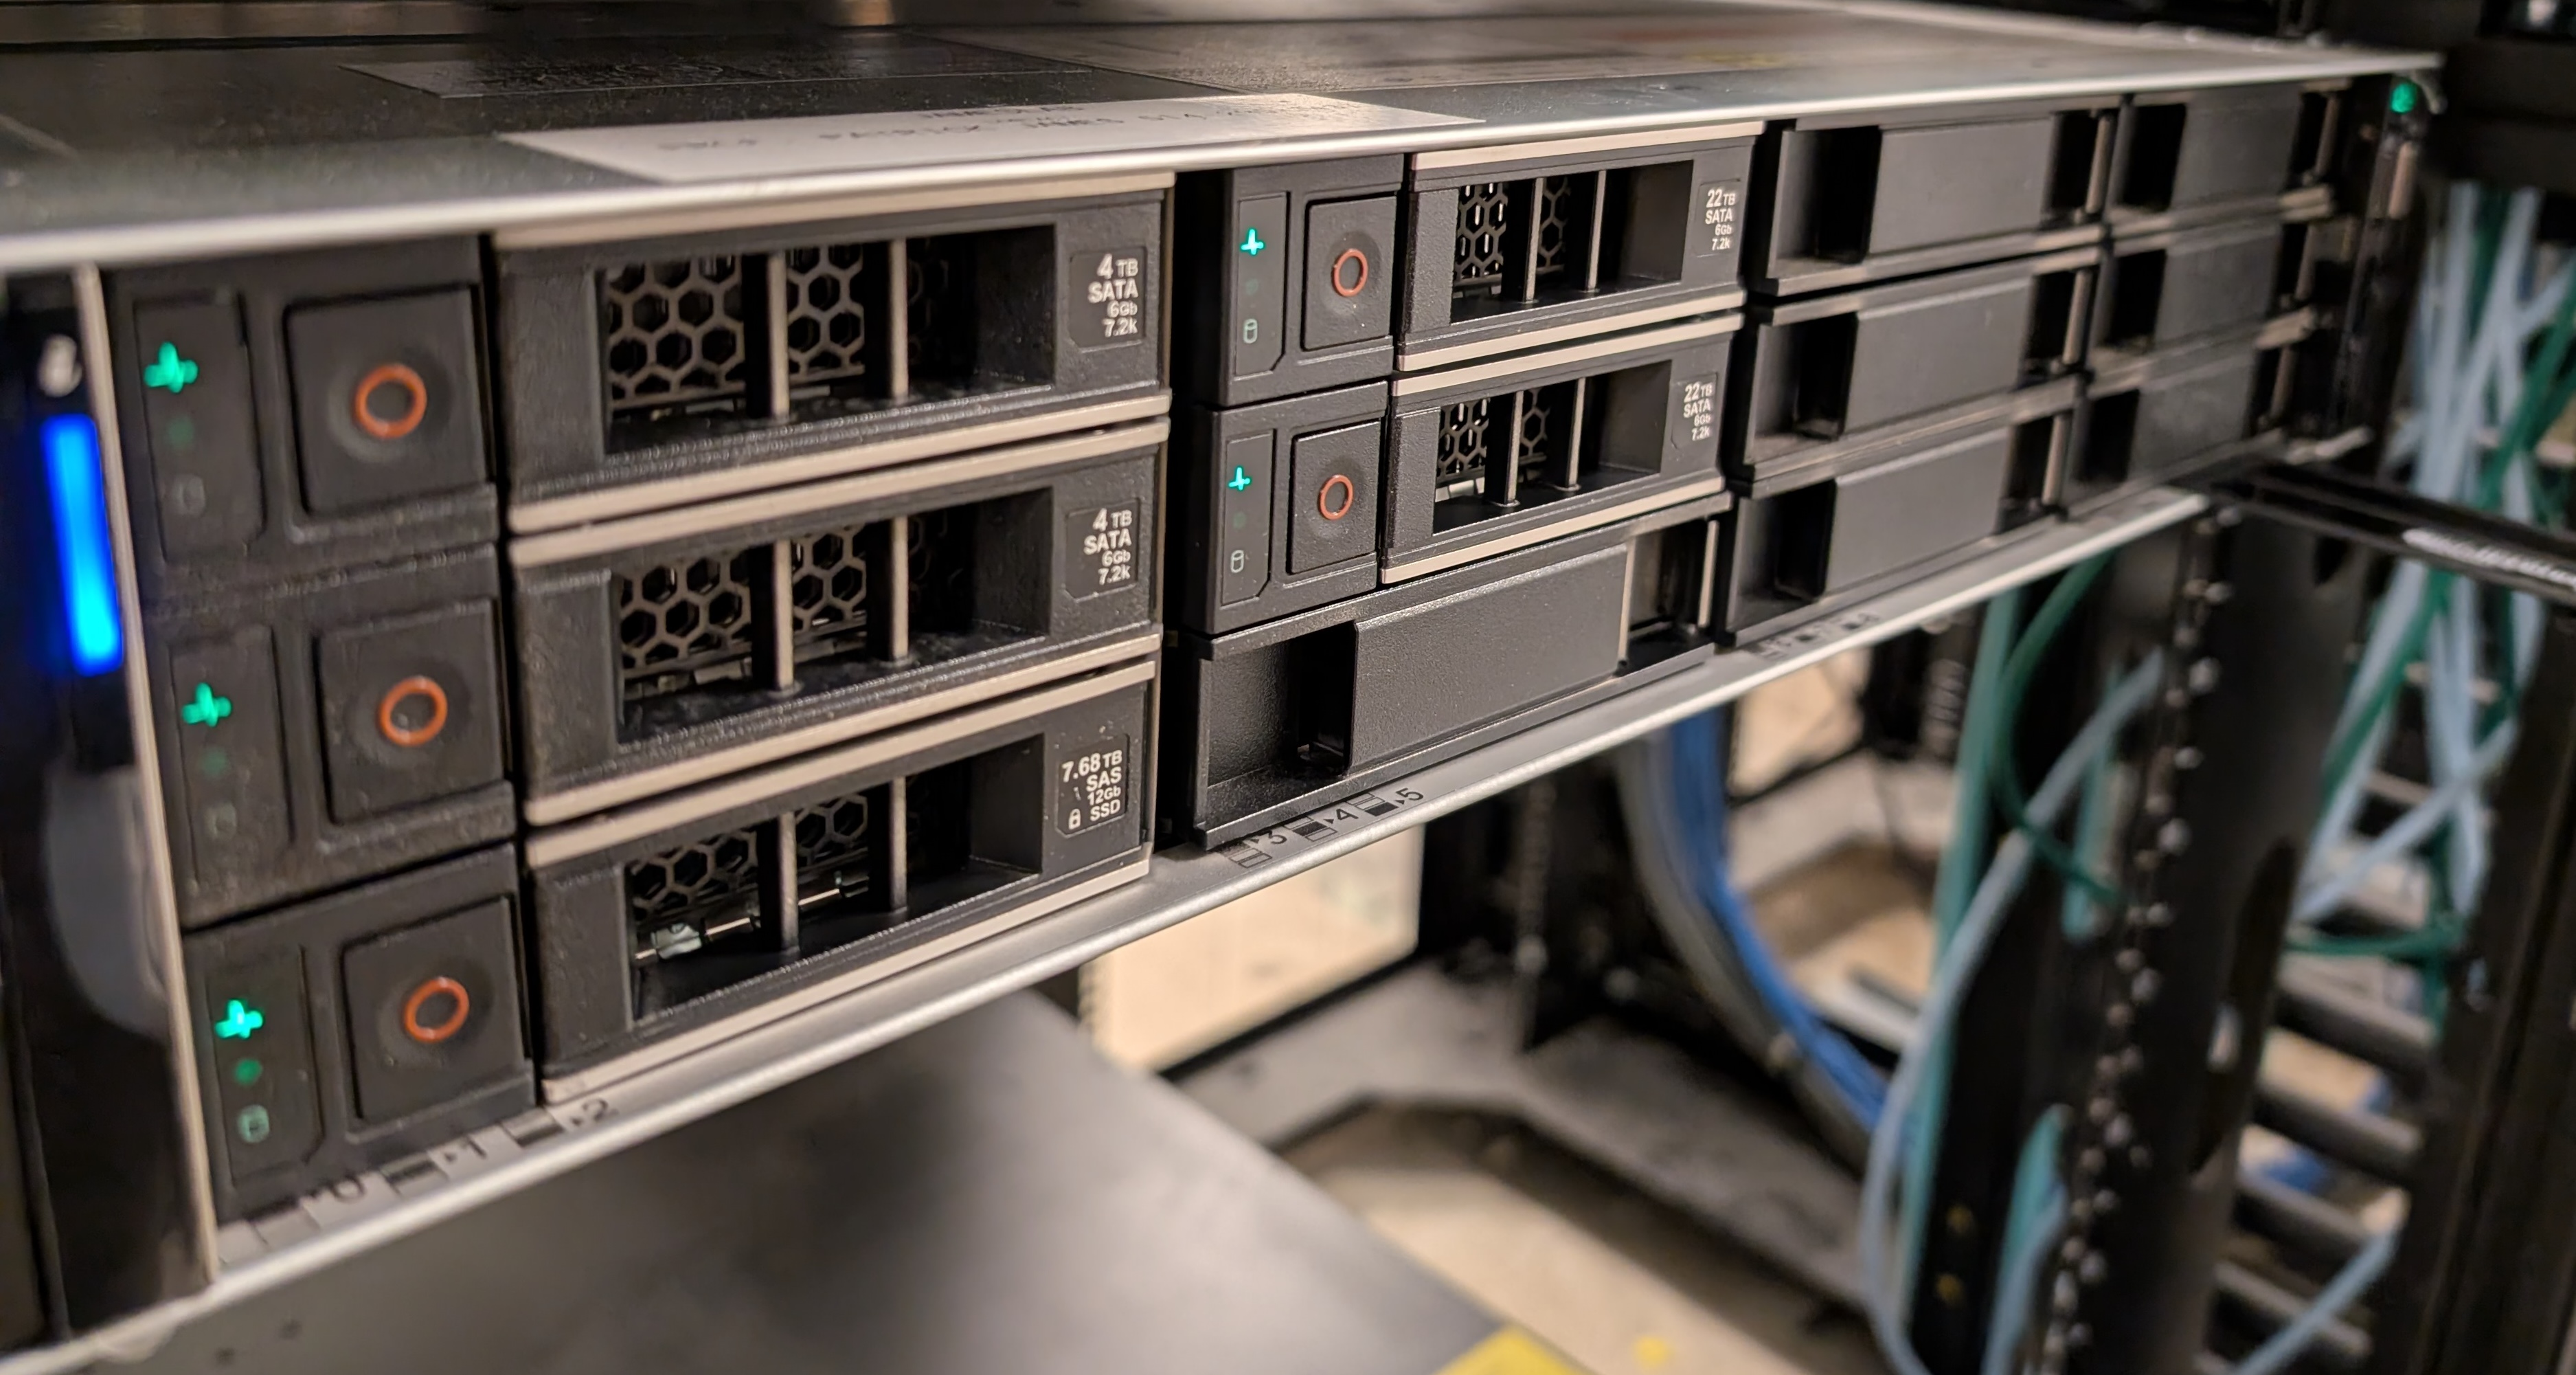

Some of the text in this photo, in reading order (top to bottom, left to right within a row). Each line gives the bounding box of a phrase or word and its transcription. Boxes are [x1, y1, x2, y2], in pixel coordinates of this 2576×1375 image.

[1705, 208, 1732, 224] SATA
[1715, 223, 1732, 236] 6Gb
[1712, 237, 1730, 251] 7.2k
[1087, 278, 1139, 303] SATA
[1107, 300, 1138, 317] 6Gb
[1102, 316, 1138, 337] 7.2k
[1683, 398, 1711, 418] SATA
[1083, 528, 1132, 555] SATA
[1102, 549, 1131, 567] 6Gb
[1098, 563, 1131, 585] 7.2k
[1086, 766, 1122, 792] SAS
[1087, 785, 1121, 806] 12Gb
[1335, 808, 1359, 821] 4
[1395, 787, 1423, 801] 5
[1090, 798, 1121, 821] SSD
